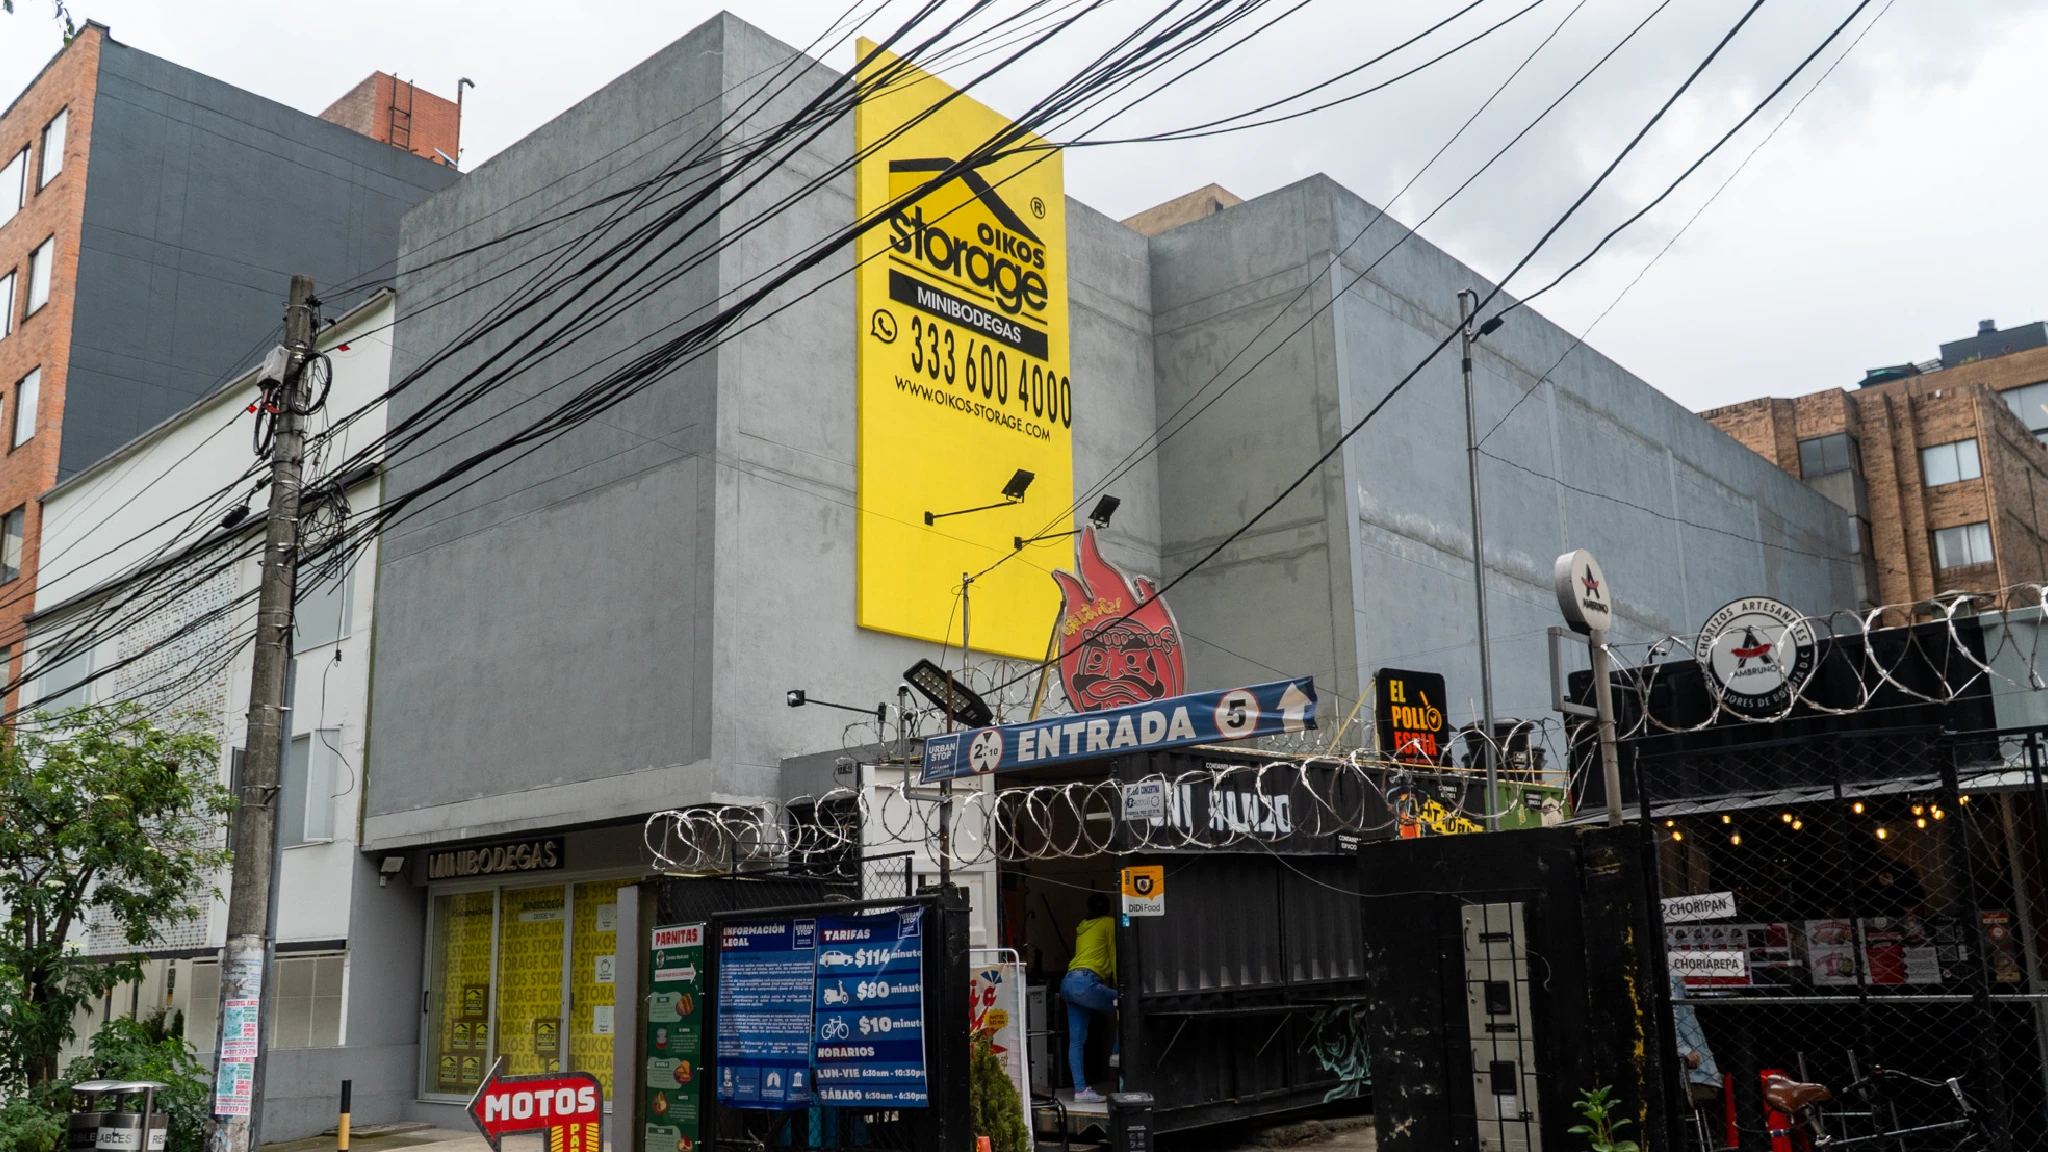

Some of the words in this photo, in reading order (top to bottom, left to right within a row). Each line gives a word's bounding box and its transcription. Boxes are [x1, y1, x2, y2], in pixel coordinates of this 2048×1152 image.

[977, 223, 1045, 270] OIKOS
[917, 286, 1022, 343] MINIBODEGAS
[911, 315, 956, 385] 333
[965, 338, 1007, 405] 600
[1018, 359, 1072, 429] 4000
[895, 375, 1050, 442] WWW.OIKOS-STORAGE.COM
[1698, 607, 1733, 658] CHORIZOS
[1742, 601, 1807, 642] ARTESANAES
[1734, 665, 1778, 678] AMBRUNO
[1389, 679, 1406, 703] EL
[1757, 697, 1770, 708] DE
[1391, 705, 1442, 732] POLLO
[1018, 706, 1197, 763] ENTRADA
[1226, 699, 1249, 729] 5
[928, 742, 956, 754] URBAN
[931, 751, 952, 762] STOP
[429, 840, 557, 879] MINIBODEGAS
[1128, 903, 1144, 913] DiDi
[1144, 903, 1161, 912] Food
[1669, 899, 1727, 916] CHORIPAN
[902, 916, 917, 925] STOP
[723, 923, 786, 936] INFORMACIÓN
[824, 928, 871, 941] TARIFAS
[722, 937, 749, 947] LEGAL
[854, 948, 891, 969] $114
[1674, 958, 1739, 970] CHORIAREPA
[857, 980, 890, 1001] $80
[858, 1015, 892, 1035] $10
[817, 1046, 875, 1058] HORARIOS
[817, 1068, 860, 1079] LUN-VIE
[862, 1069, 889, 1077] 6:30am
[820, 1087, 862, 1100] SÁBADO
[865, 1092, 894, 1100] 6:30am
[485, 1086, 596, 1122] MOTOS
